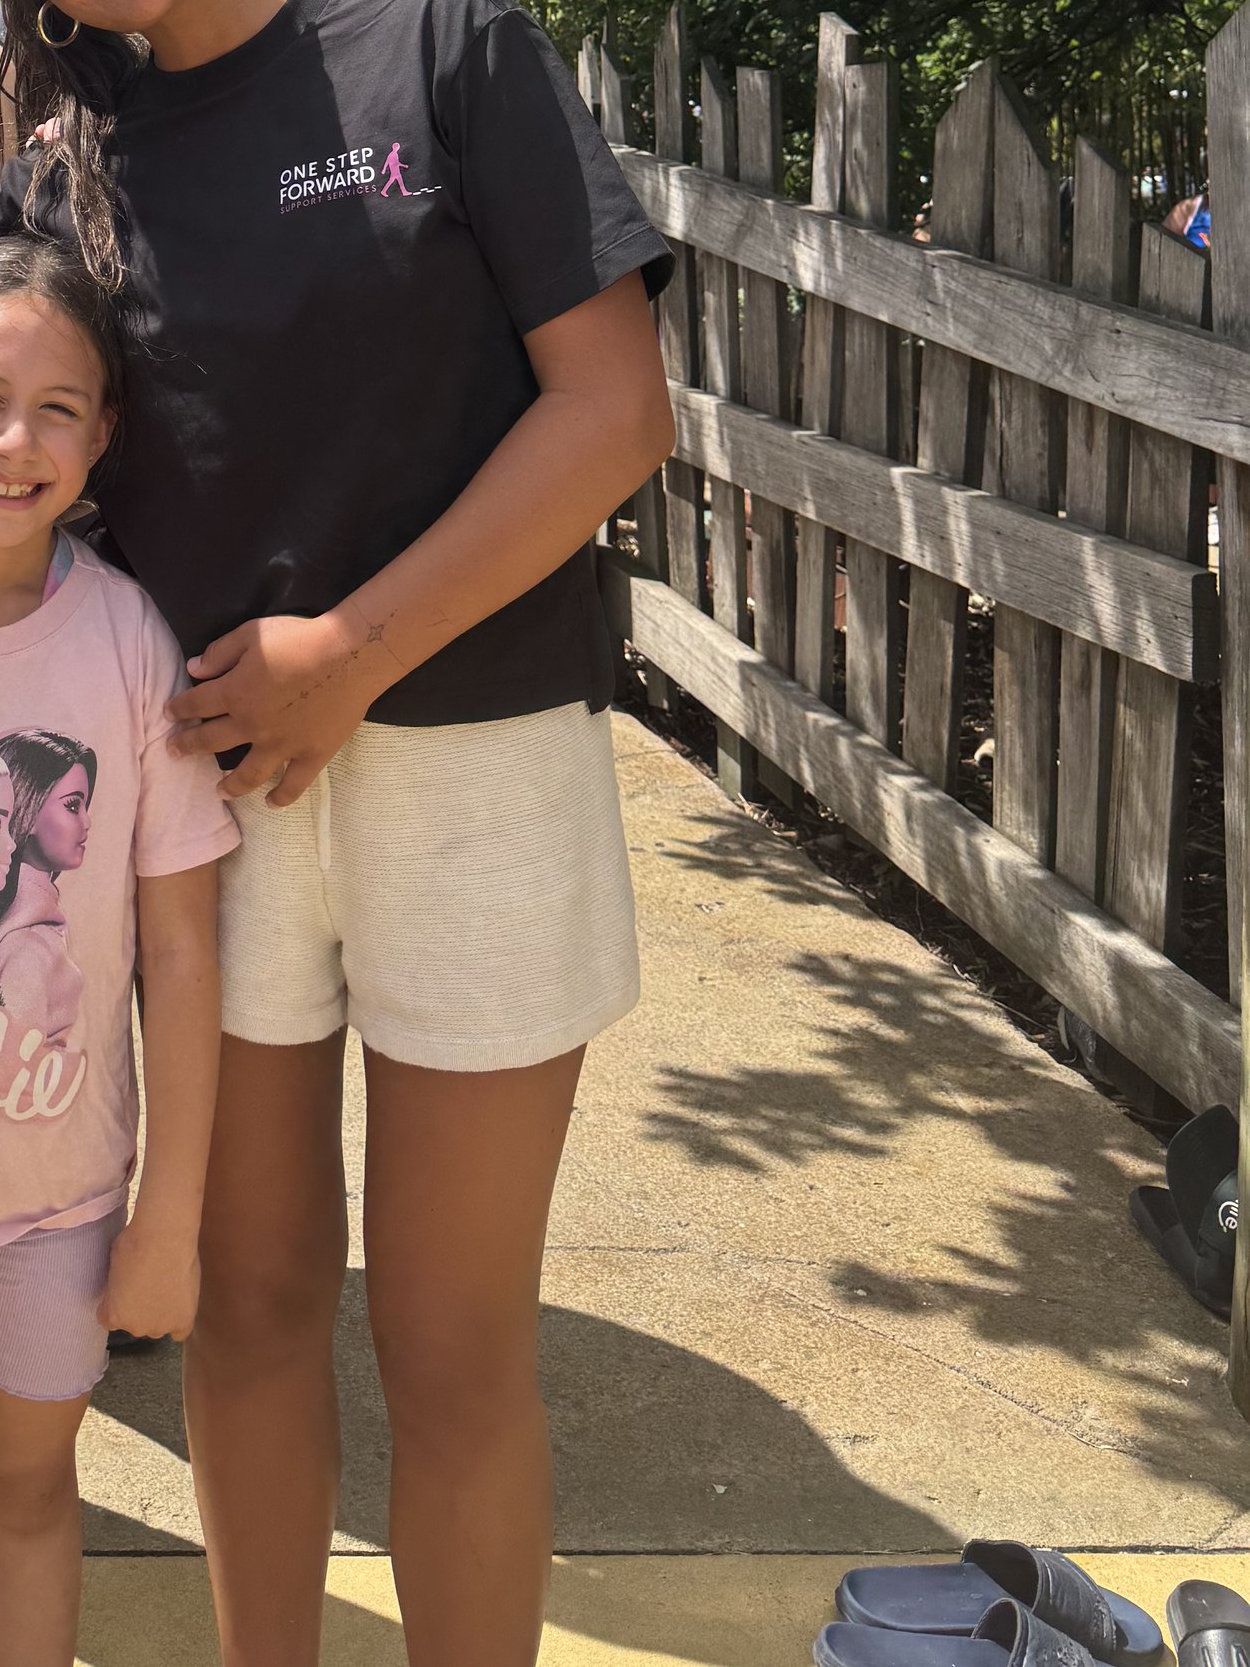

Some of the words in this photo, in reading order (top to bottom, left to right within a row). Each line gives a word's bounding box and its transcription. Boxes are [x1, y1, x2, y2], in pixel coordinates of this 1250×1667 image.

[280, 161, 318, 184] ONE
[326, 147, 373, 173] STEP
[280, 166, 375, 205] FORWARD
[280, 196, 322, 214] SUPPORT
[327, 184, 377, 201] SERVICES
